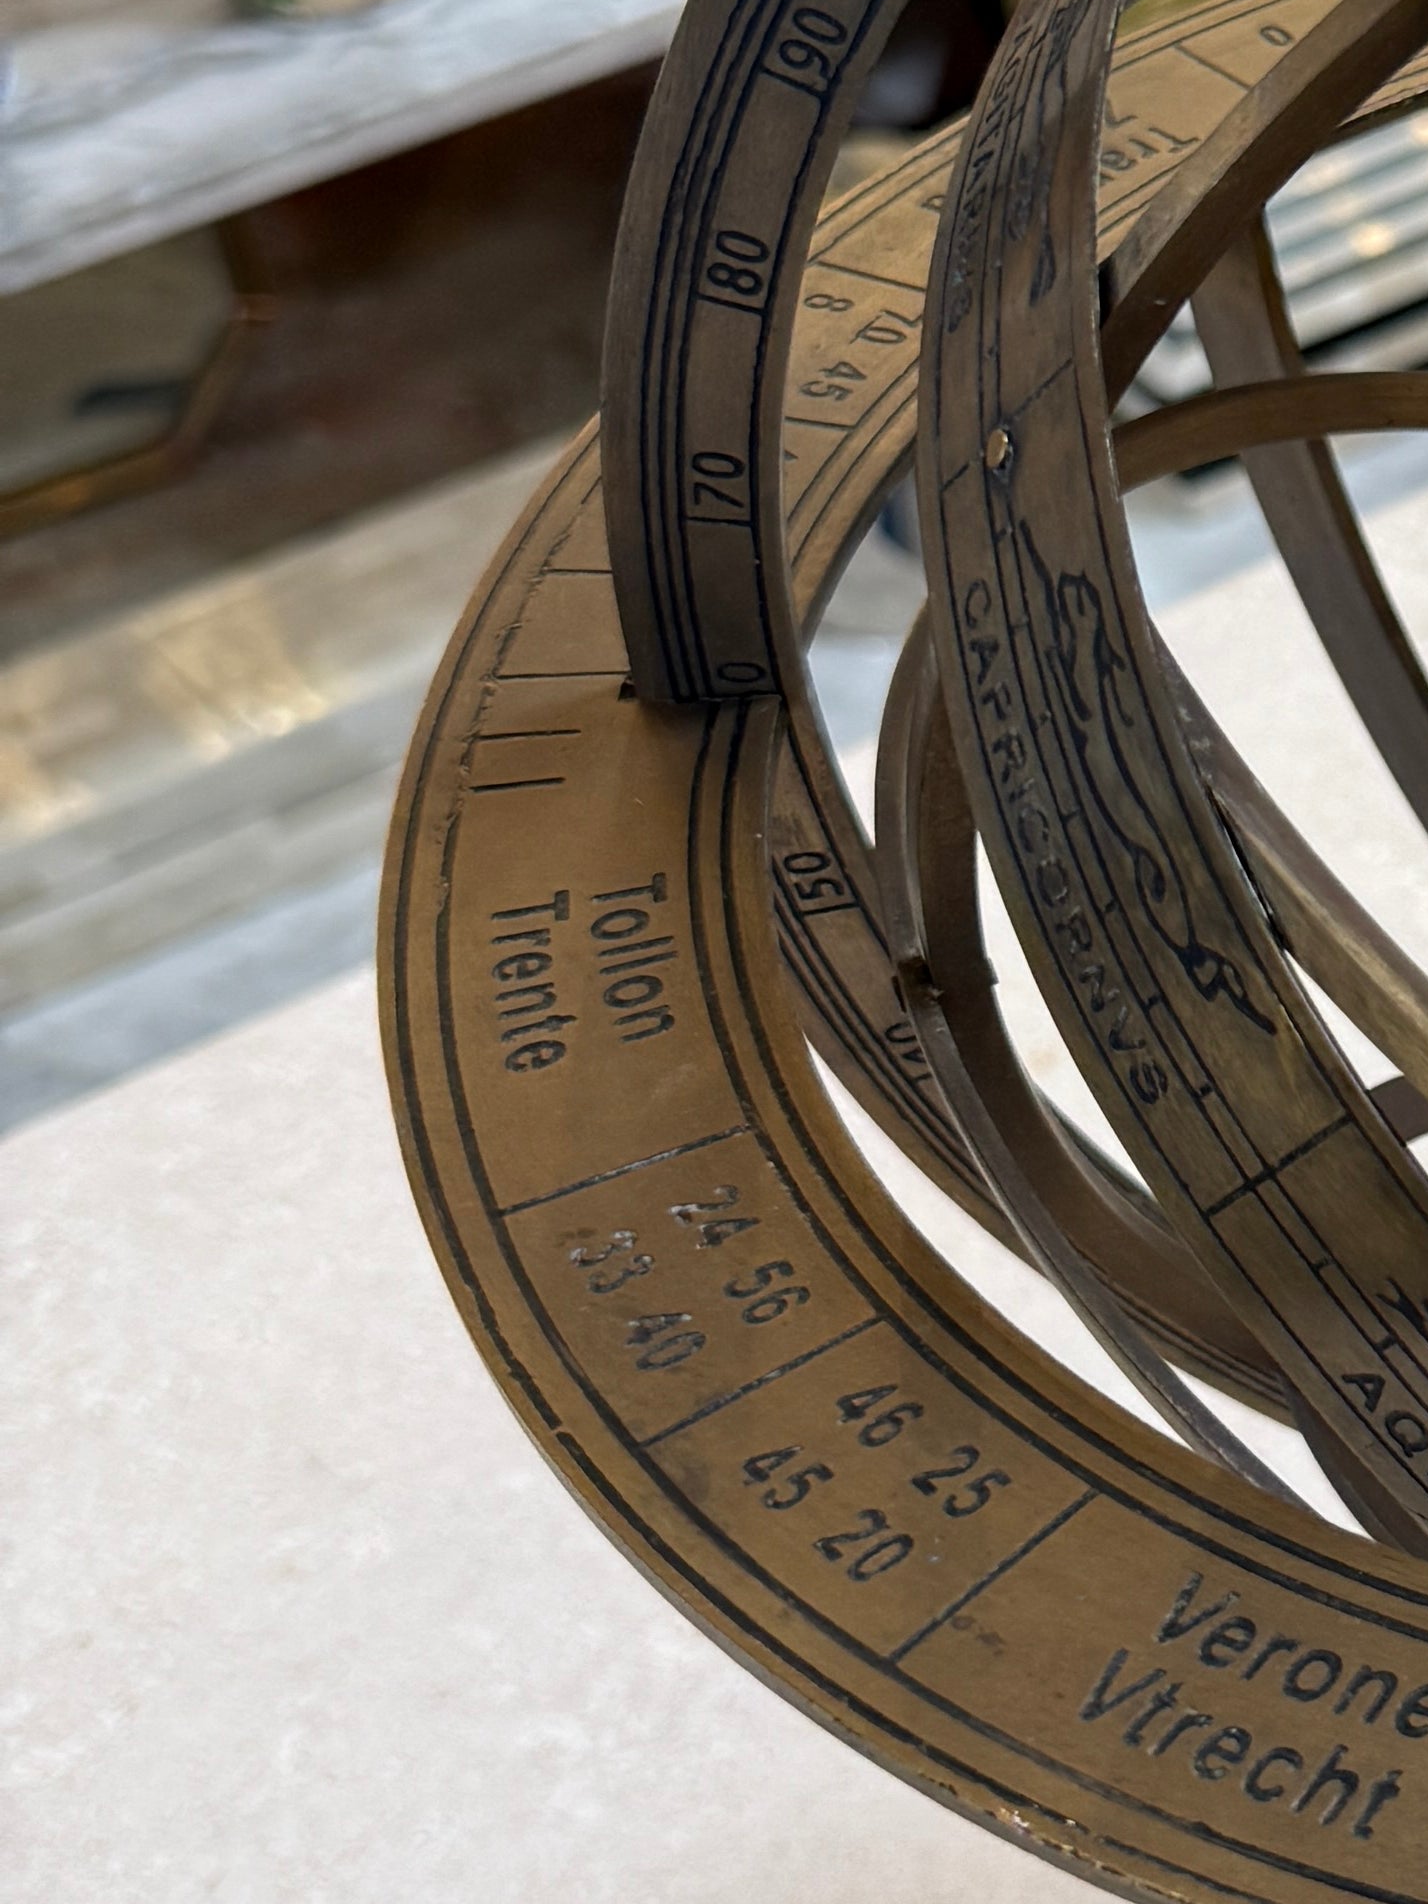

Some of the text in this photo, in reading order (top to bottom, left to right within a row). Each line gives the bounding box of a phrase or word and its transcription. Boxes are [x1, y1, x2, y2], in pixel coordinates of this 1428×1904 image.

[779, 6, 849, 86] 90
[707, 228, 771, 298] 80
[690, 449, 746, 511] 70
[784, 849, 847, 904] 50
[963, 576, 1171, 1106] CAPRICORNVS
[490, 888, 579, 1075] Trente
[589, 870, 679, 1045] Tollon
[566, 1227, 707, 1373] 33 40
[668, 1182, 812, 1326] 24 56
[740, 1443, 917, 1583] 45 20
[834, 1380, 1013, 1520] 46 25
[1077, 1646, 1406, 1842] Vtrecht
